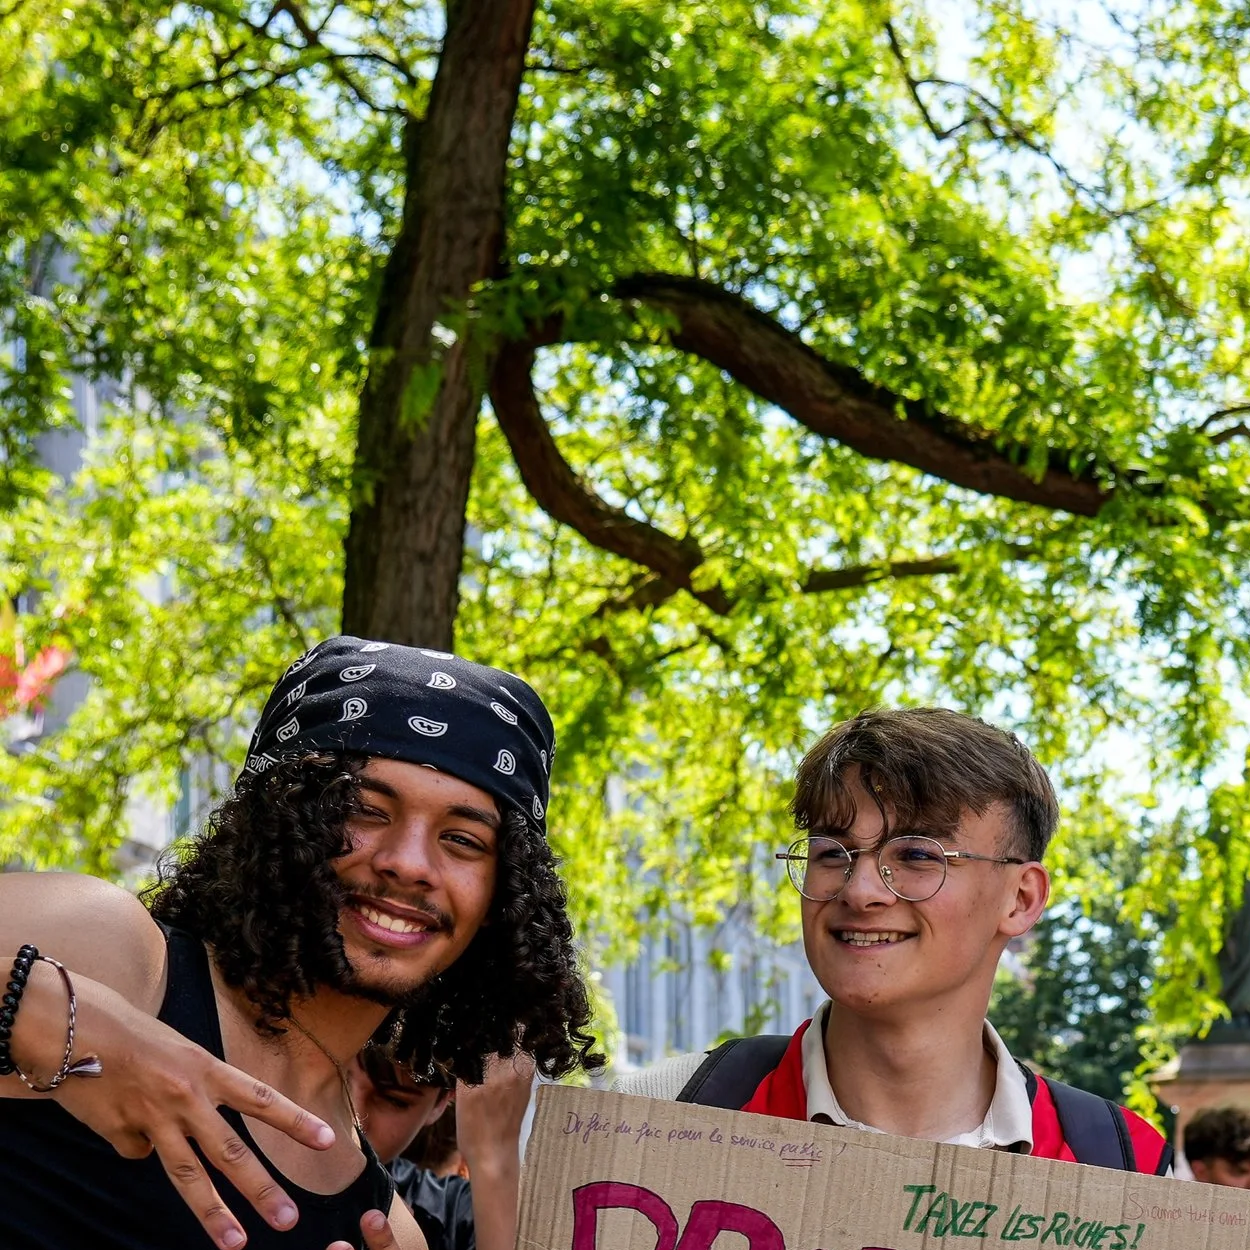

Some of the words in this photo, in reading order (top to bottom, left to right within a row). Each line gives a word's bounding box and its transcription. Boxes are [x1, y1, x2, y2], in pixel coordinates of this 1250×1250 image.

[708, 1127, 724, 1145] le
[730, 1134, 776, 1152] service
[902, 1184, 998, 1238] TAXEZ
[1000, 1204, 1046, 1241] LES
